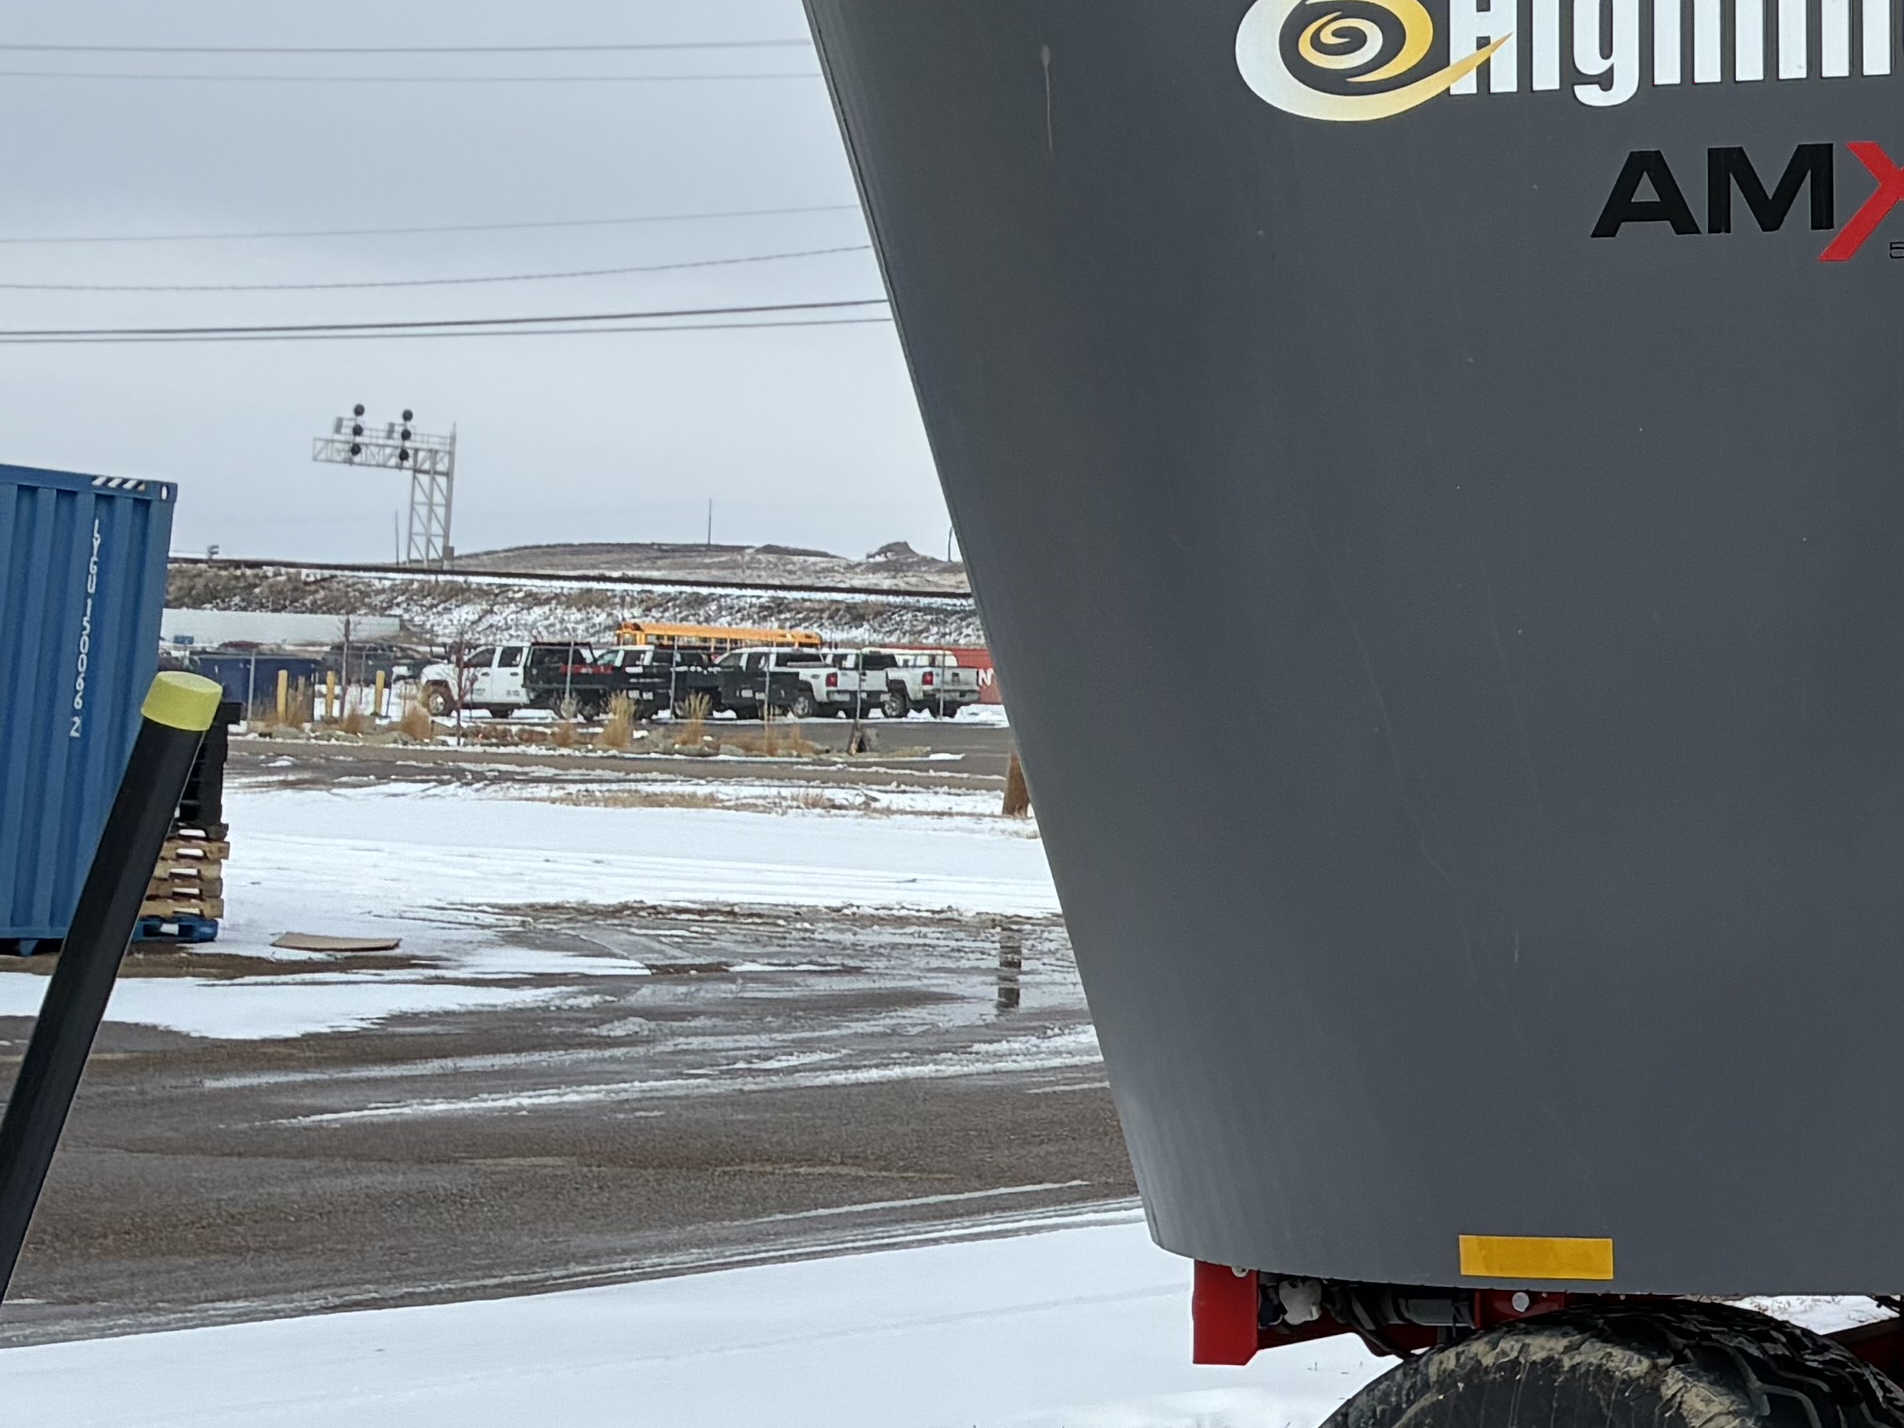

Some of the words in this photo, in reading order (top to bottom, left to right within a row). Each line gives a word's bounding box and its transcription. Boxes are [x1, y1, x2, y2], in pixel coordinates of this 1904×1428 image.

[86, 518, 101, 594] LYGU
[73, 598, 92, 710] 150066
[69, 716, 82, 738] 2
